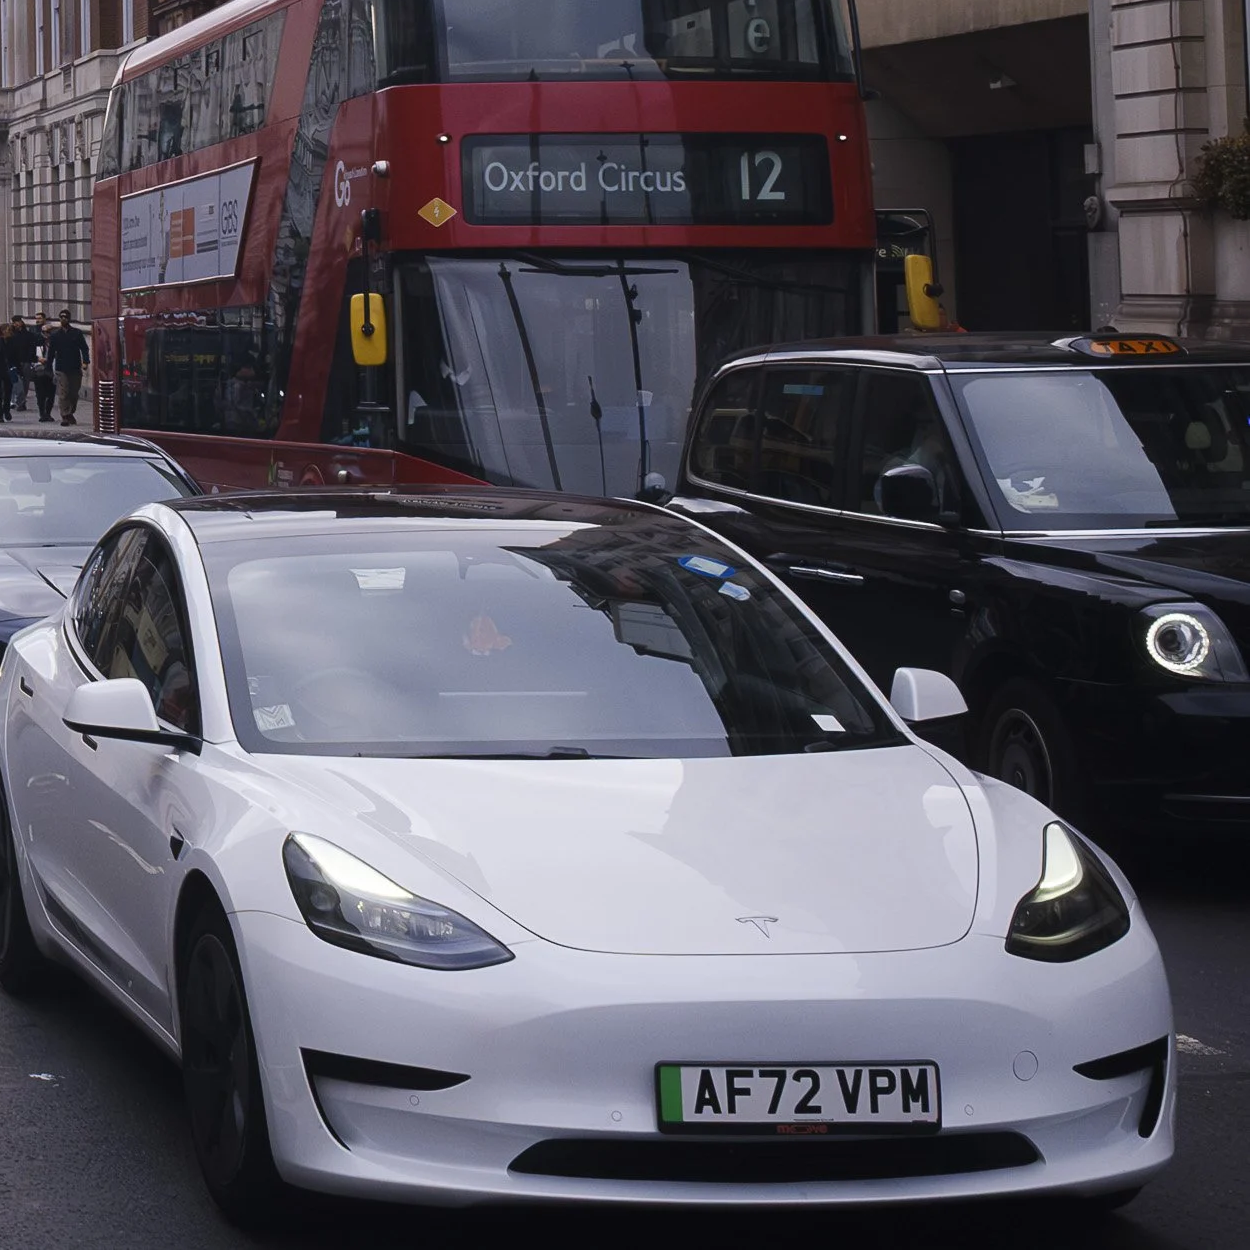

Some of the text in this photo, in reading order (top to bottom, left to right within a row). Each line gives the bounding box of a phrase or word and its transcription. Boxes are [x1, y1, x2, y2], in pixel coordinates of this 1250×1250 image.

[484, 161, 686, 192] Oxford Circus
[739, 150, 786, 201] 12
[1096, 341, 1171, 353] TAXI
[694, 1068, 930, 1114] AF72 VPM
